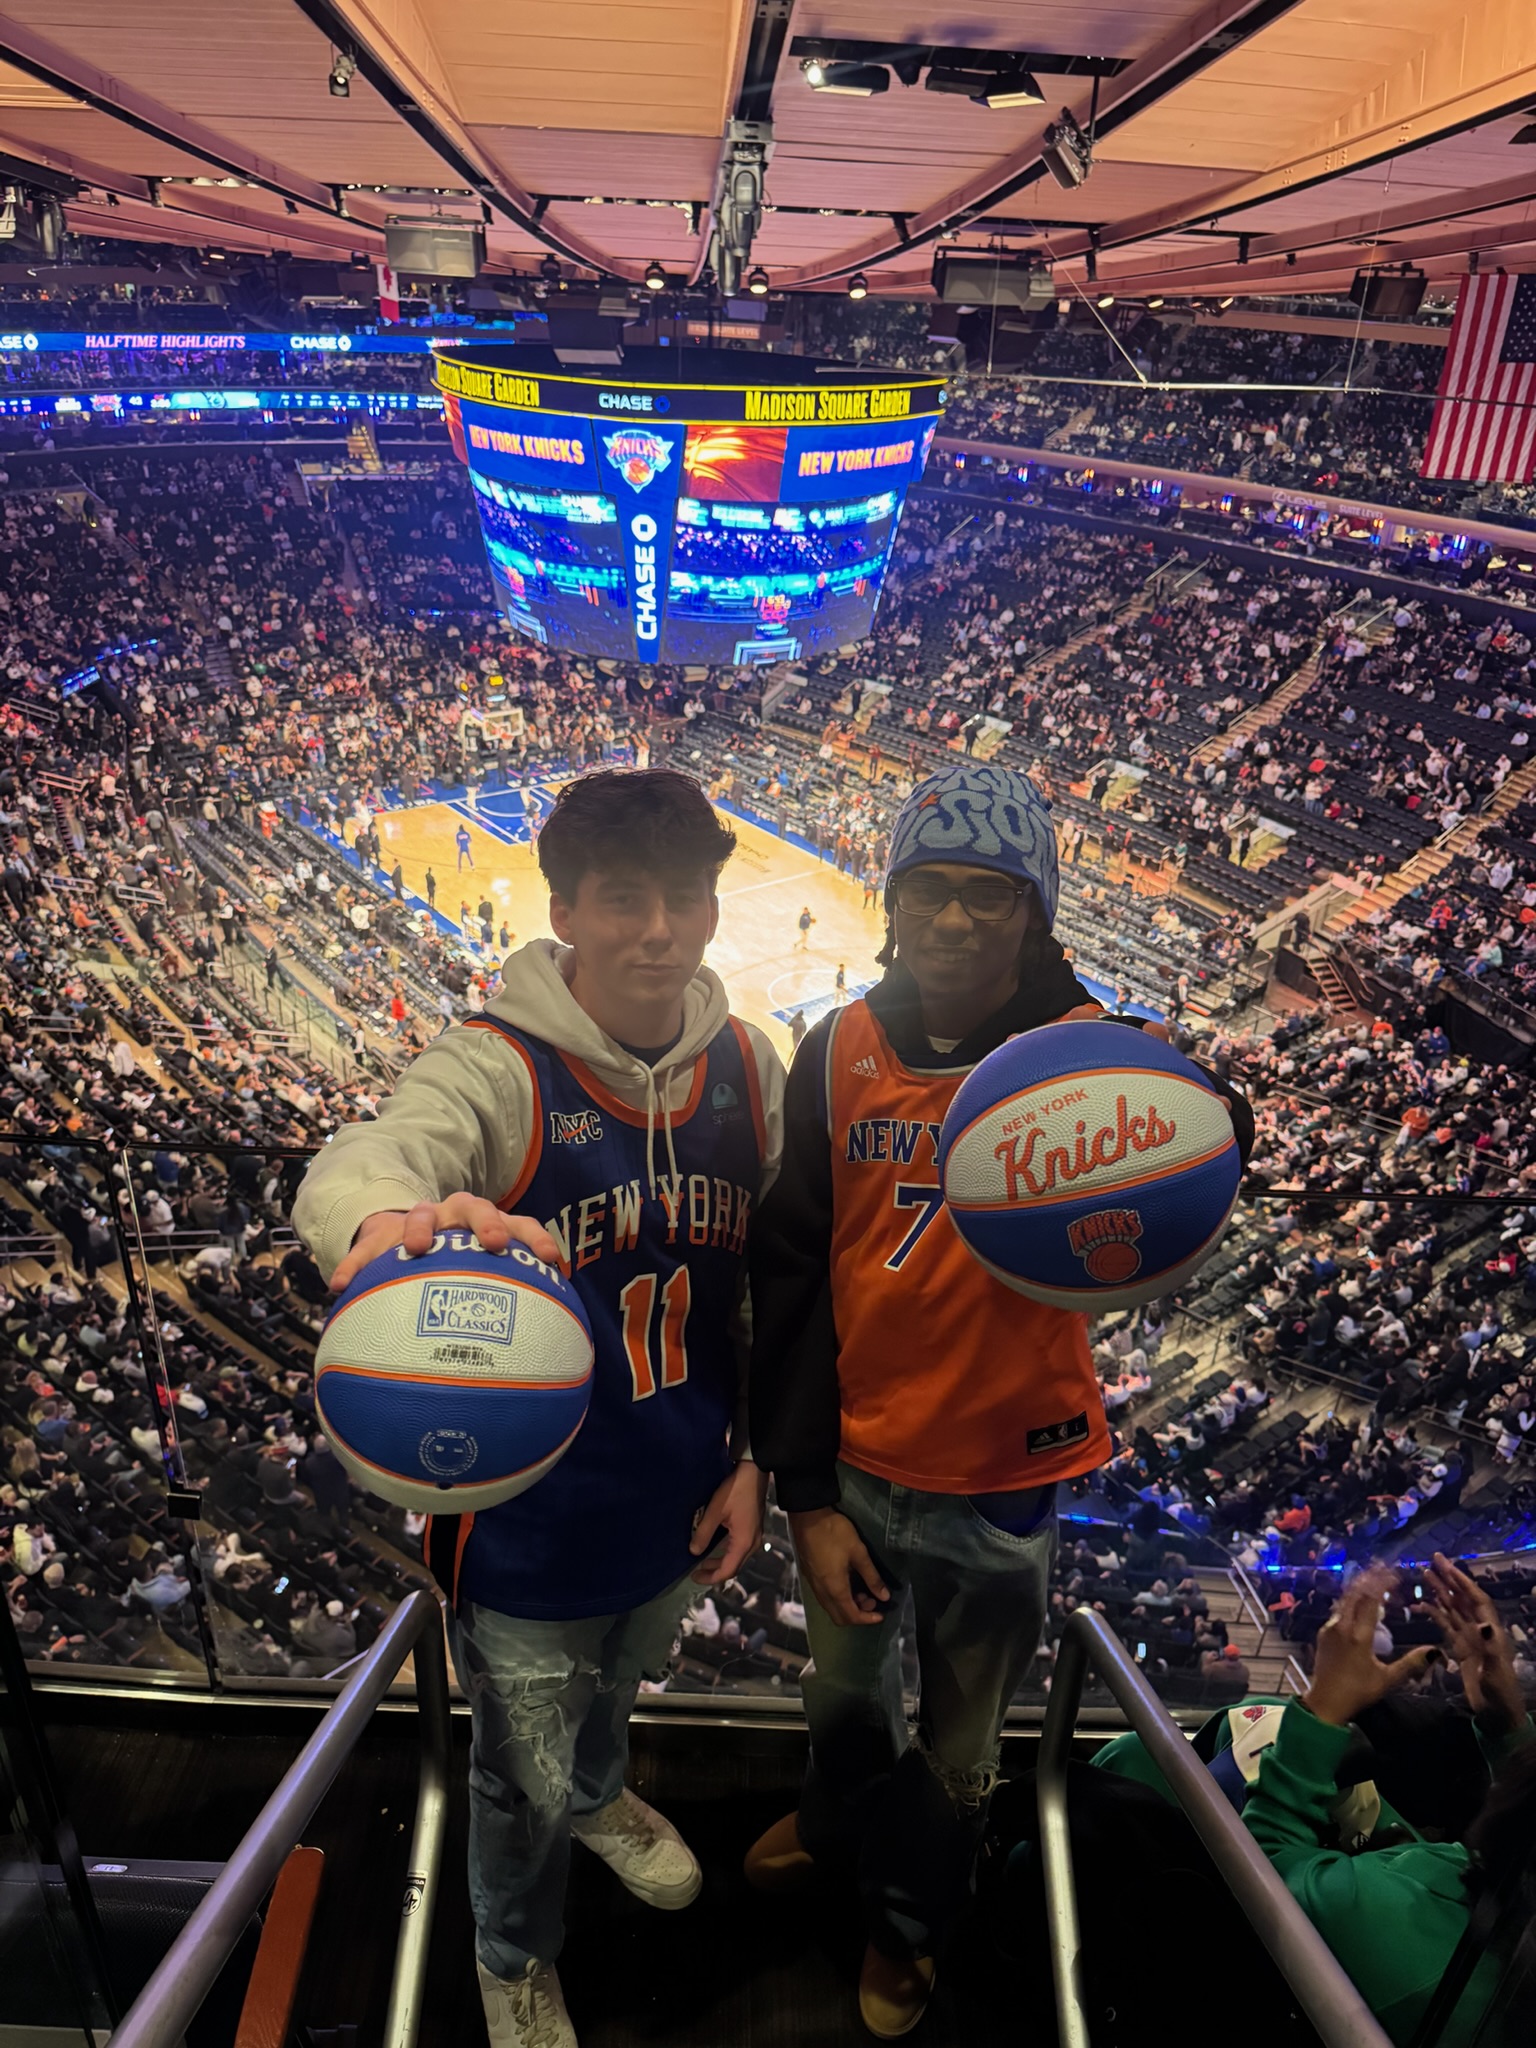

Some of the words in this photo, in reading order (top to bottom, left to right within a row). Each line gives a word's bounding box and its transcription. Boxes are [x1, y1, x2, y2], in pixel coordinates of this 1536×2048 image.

[85, 336, 157, 348] HALFTIME
[161, 336, 246, 348] HIGHLIGHTS
[290, 336, 338, 349] CHASE
[460, 366, 494, 399] SQUARE
[493, 373, 540, 407] GARDEN
[598, 392, 653, 411] CHASE
[745, 390, 816, 421] MADISON
[818, 391, 869, 421] SQUARE
[869, 389, 911, 418] GARDEN
[488, 429, 524, 456] YORK
[522, 434, 585, 465] KNICKS
[608, 436, 667, 462] KNICKS
[798, 450, 835, 477] NEW
[836, 447, 874, 473] YORK
[873, 440, 915, 468] KNICKS
[1361, 507, 1384, 519] LEVEL
[634, 544, 658, 640] CHASE
[850, 1066, 880, 1079] adidas
[550, 1110, 603, 1144] NYC
[1002, 1111, 1037, 1136] NEW
[1040, 1088, 1089, 1116] YORK
[846, 1119, 925, 1165] NEW
[994, 1094, 1176, 1202] Knicks
[545, 1179, 643, 1280] NEW
[656, 1174, 752, 1256] YORK
[883, 1182, 944, 1272] 7
[1069, 1210, 1142, 1255] KNICKS
[449, 1290, 508, 1313] HARDWOOD
[447, 1310, 507, 1334] CLASSICS
[619, 1262, 691, 1402] 11
